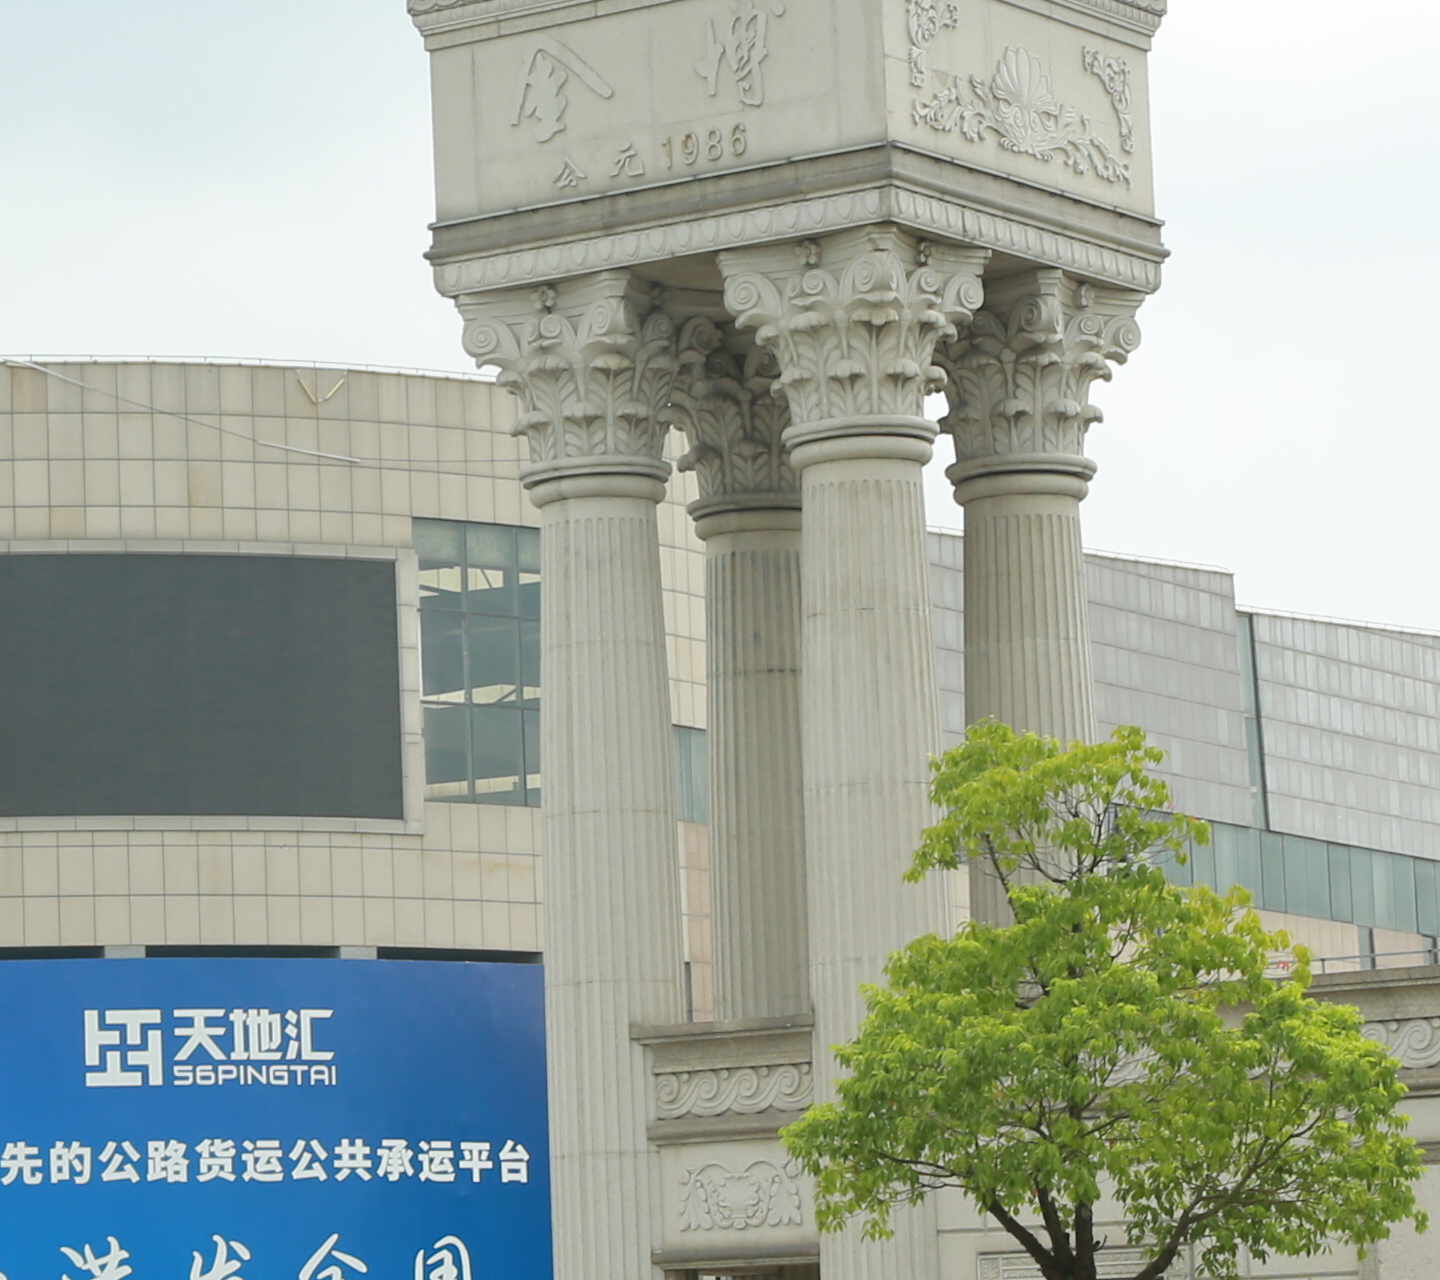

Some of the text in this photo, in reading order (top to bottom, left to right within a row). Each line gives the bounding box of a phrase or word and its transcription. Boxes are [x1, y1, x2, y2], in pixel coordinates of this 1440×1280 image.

[172, 1008, 336, 1061] 天地汇
[172, 1064, 338, 1087] 56PINGTAI
